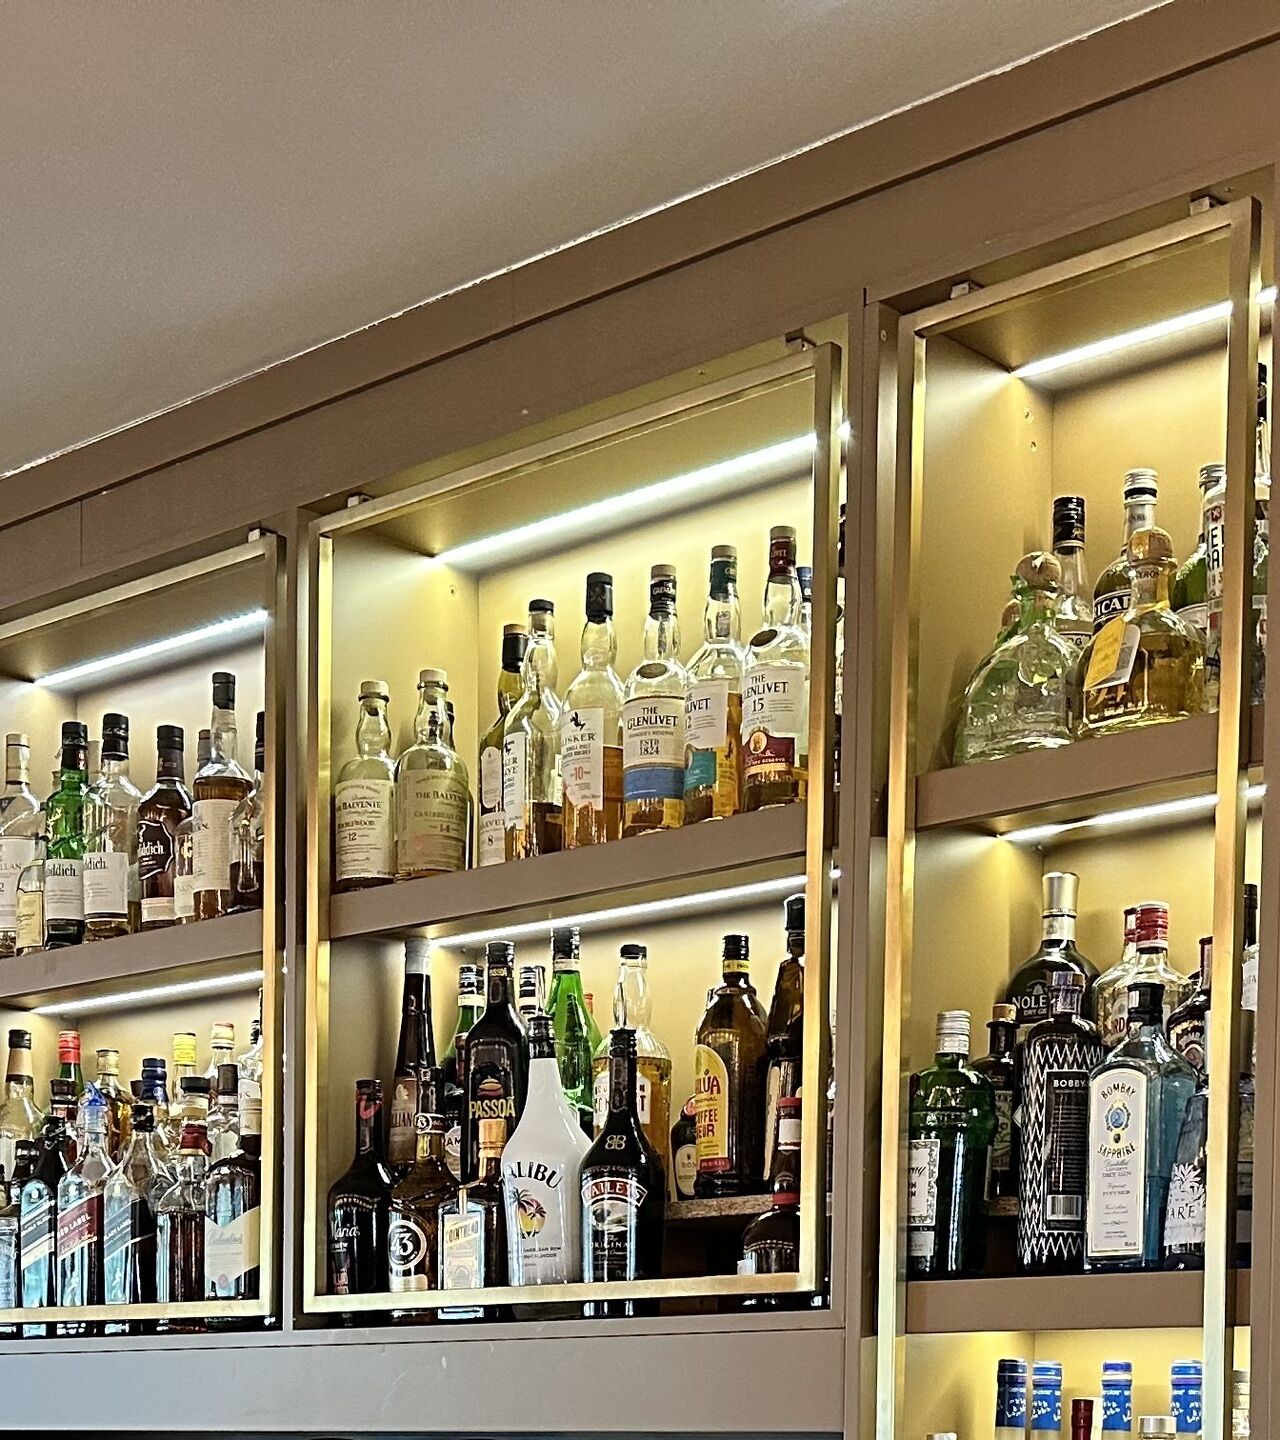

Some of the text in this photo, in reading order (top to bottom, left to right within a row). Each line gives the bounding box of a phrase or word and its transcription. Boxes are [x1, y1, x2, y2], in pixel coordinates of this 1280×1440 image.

[751, 673, 766, 684] THE
[642, 706, 658, 716] THE
[752, 697, 765, 714] 15
[627, 715, 678, 731] GLENLIVET
[639, 747, 660, 756] 1824
[573, 766, 584, 781] 10
[439, 823, 451, 833] 14
[348, 832, 357, 841] 12
[1012, 995, 1048, 1009] NOLE
[1100, 1082, 1137, 1101] BOMBAY
[1097, 1141, 1138, 1160] SAPPHIRE
[70, 1212, 92, 1231] LABEL
[390, 1231, 414, 1256] 43
